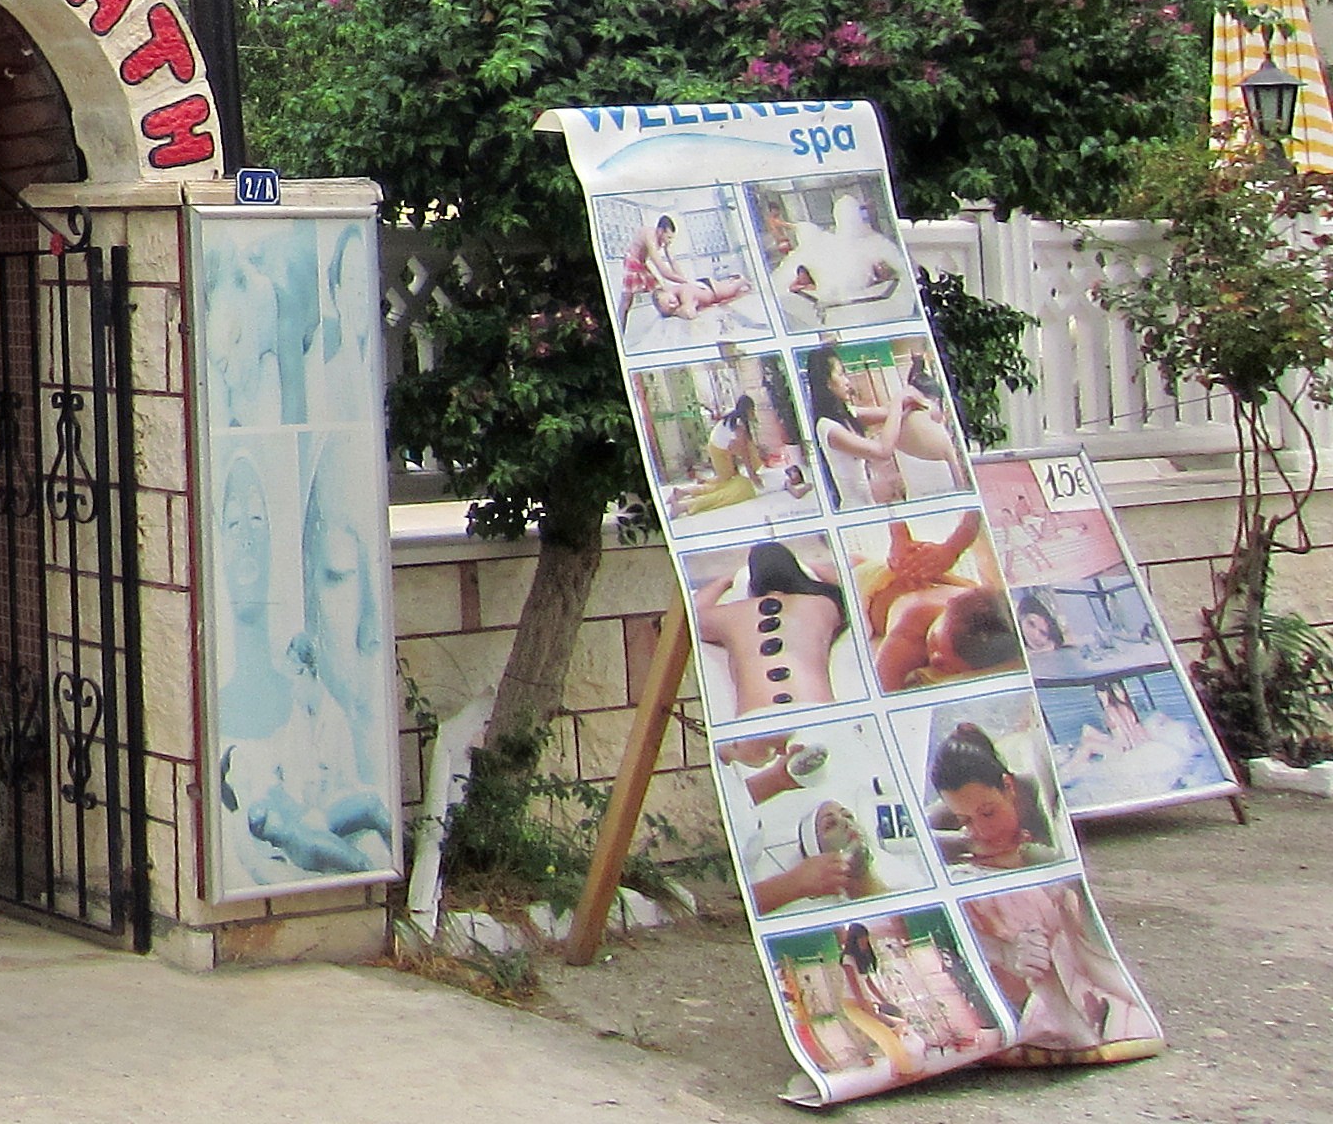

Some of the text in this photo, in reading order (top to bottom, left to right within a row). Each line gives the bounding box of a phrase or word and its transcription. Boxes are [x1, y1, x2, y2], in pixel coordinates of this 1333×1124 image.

[789, 124, 857, 165] spa
[245, 176, 274, 200] 2/A
[1045, 463, 1091, 502] 15€
